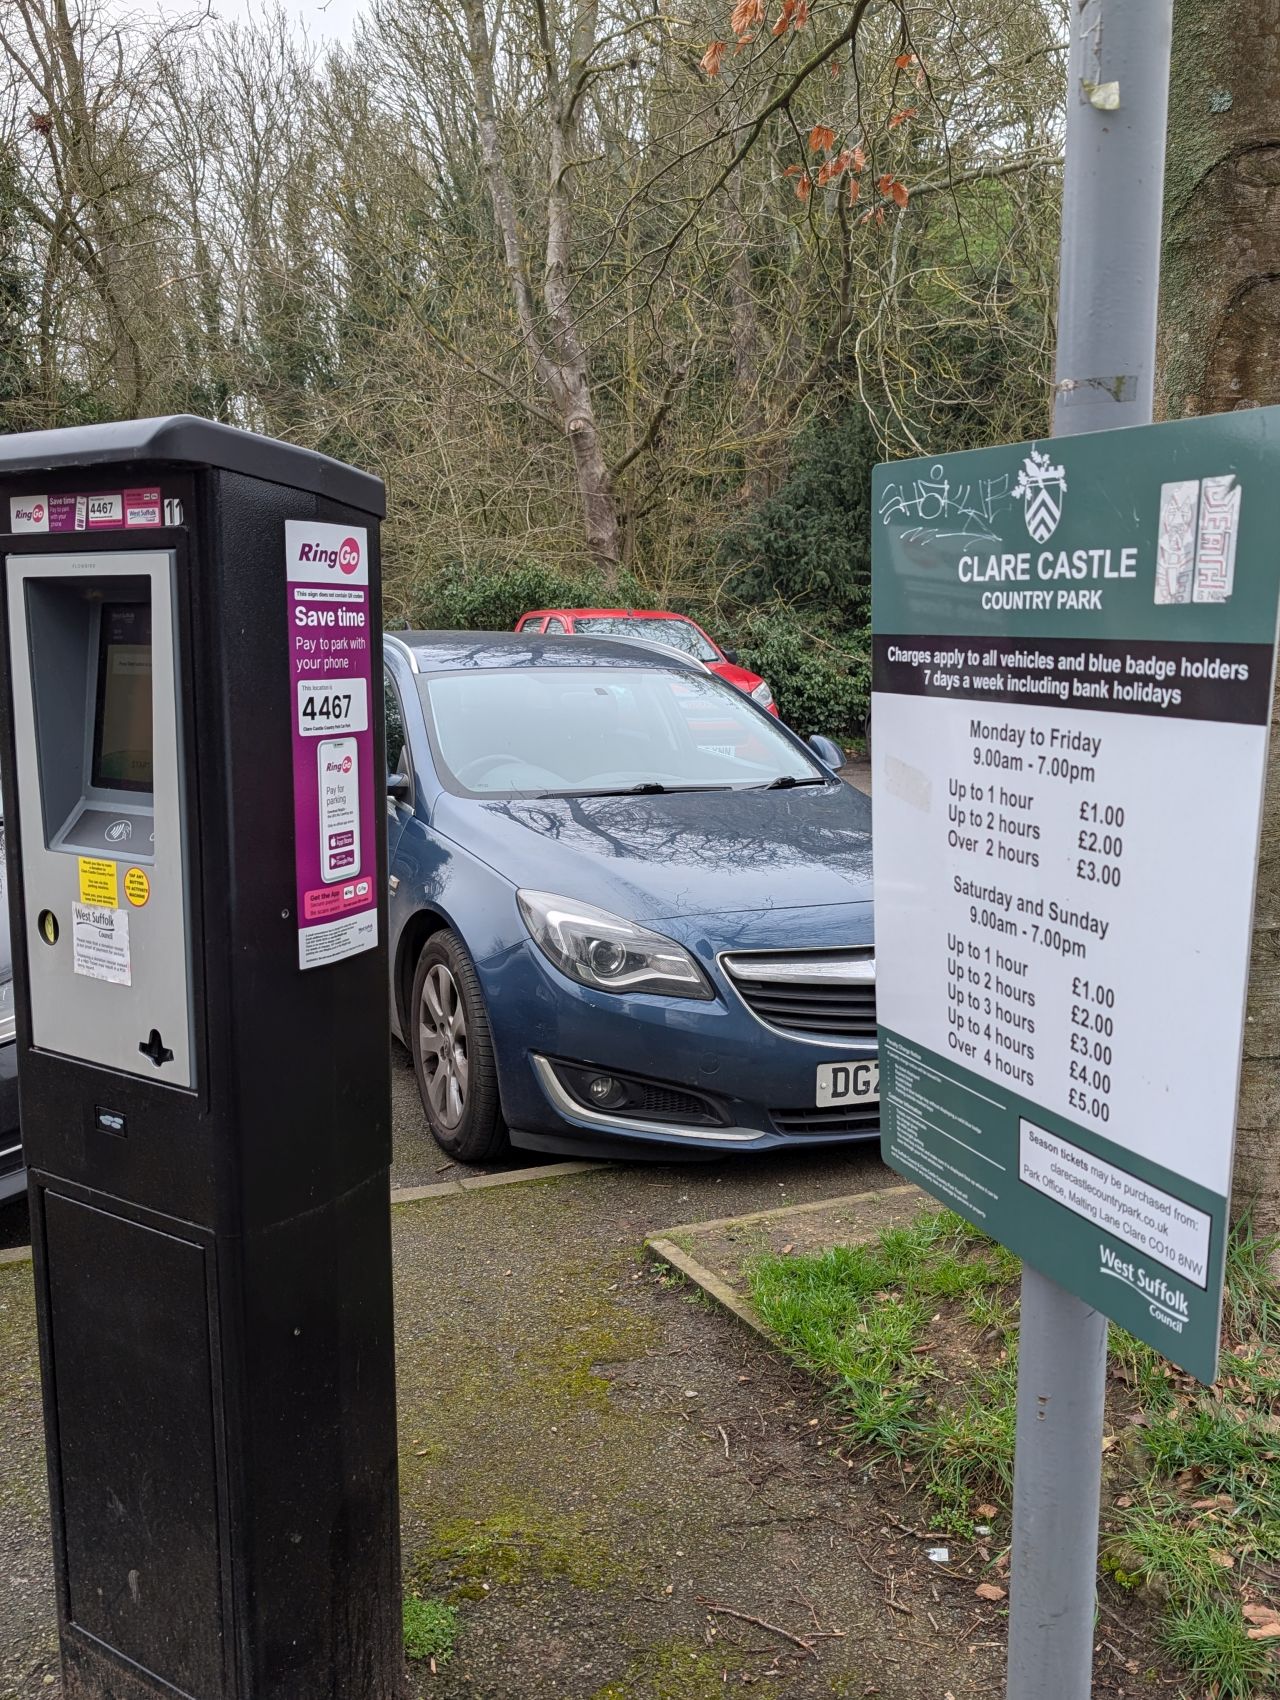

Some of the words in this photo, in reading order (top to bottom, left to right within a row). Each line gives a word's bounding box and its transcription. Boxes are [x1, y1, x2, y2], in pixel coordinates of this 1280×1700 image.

[15, 508, 44, 522] RingGo
[50, 497, 63, 505] Save
[90, 501, 114, 515] 4467
[298, 542, 359, 569] RingGo
[958, 553, 1031, 582] CLARE
[1037, 548, 1138, 580] CASTLE
[295, 605, 335, 627] Save
[338, 606, 365, 627] time
[981, 590, 1054, 610] COUNTRY
[1057, 589, 1103, 610] PARK
[296, 636, 317, 653] Pay
[320, 637, 330, 650] to
[331, 637, 349, 652] park
[350, 636, 366, 650] with
[887, 646, 931, 666] Charges
[933, 649, 965, 668] apply
[967, 650, 979, 666] to
[982, 650, 997, 666] all
[1000, 651, 1054, 669] vehicles
[1057, 653, 1085, 671] and
[1088, 653, 1121, 673] blue
[1125, 655, 1176, 680] badge
[1180, 657, 1249, 680] holders
[296, 658, 321, 672] your
[324, 656, 349, 671] phone
[302, 694, 352, 721] 4467
[924, 670, 931, 685] 7
[933, 670, 960, 690] days
[962, 675, 970, 688] a
[973, 674, 1004, 690] week
[1007, 674, 1069, 699] including
[1072, 678, 1109, 699] bank
[1113, 681, 1182, 708] holidays
[970, 720, 1025, 748] Monday
[1030, 727, 1045, 746] to
[1050, 728, 1102, 757] Friday
[973, 747, 1023, 771] 9.00am
[1038, 755, 1095, 784] 7.00pm
[326, 786, 337, 796] Pay
[337, 785, 345, 793] for
[326, 795, 347, 807] parking
[949, 778, 966, 801] Up
[970, 783, 983, 801] to
[988, 785, 994, 803] 1
[999, 787, 1034, 811] hour
[1079, 801, 1125, 828] £1.00
[949, 804, 966, 827] Up
[970, 809, 983, 828] to
[986, 812, 995, 830] 2
[999, 813, 1041, 840] hours
[1078, 830, 1123, 858] £2.00
[948, 829, 978, 853] Over
[986, 838, 994, 856] 2
[998, 840, 1040, 868] hours
[1076, 859, 1121, 887] £3.00
[75, 907, 91, 922] West
[92, 911, 115, 927] Suffolk
[953, 875, 1013, 912] Saturday
[1017, 897, 1043, 917] and
[1049, 901, 1109, 940] Sunday
[970, 905, 1017, 937] 9.00am
[1031, 924, 1086, 958] 7.00pm
[948, 932, 964, 957] Up
[968, 940, 980, 960] to
[984, 947, 991, 964] 1
[996, 949, 1028, 977] hour
[1072, 976, 1115, 1009] £1.00
[948, 957, 964, 981] Up
[968, 966, 980, 985] to
[984, 972, 992, 990] 2
[996, 975, 1035, 1007] hours
[1071, 1005, 1113, 1037] £2.00
[948, 982, 964, 1006] Up
[968, 991, 980, 1010] to
[984, 997, 991, 1015] 3
[995, 1001, 1035, 1034] hours
[1070, 1032, 1112, 1066] £3.00
[948, 1006, 964, 1031] Up
[968, 1017, 980, 1036] to
[983, 1023, 991, 1041] 4
[995, 1027, 1035, 1060] hours
[1069, 1060, 1111, 1094] £4.00
[948, 1031, 977, 1059] Over
[983, 1049, 991, 1066] 4
[995, 1053, 1034, 1087] hours
[1068, 1088, 1110, 1122] £5.00
[1029, 1131, 1058, 1156] Season
[1060, 1148, 1089, 1172] tickets
[1090, 1165, 1109, 1185] may
[1110, 1173, 1122, 1189] be
[1123, 1183, 1171, 1217] purchased
[1173, 1208, 1199, 1231] from:
[1050, 1162, 1169, 1236] clarecastlecountrypark.co.uk
[1023, 1164, 1041, 1183] Park
[1042, 1175, 1067, 1200] Office,
[1069, 1190, 1097, 1219] Malting
[1100, 1209, 1121, 1229] Lane
[1122, 1221, 1146, 1244] Clare
[1148, 1236, 1176, 1262] CO10
[1178, 1255, 1203, 1276] 8NW
[1099, 1244, 1135, 1281] West
[1137, 1269, 1188, 1315] Suffolk
[1149, 1304, 1182, 1334] Council
